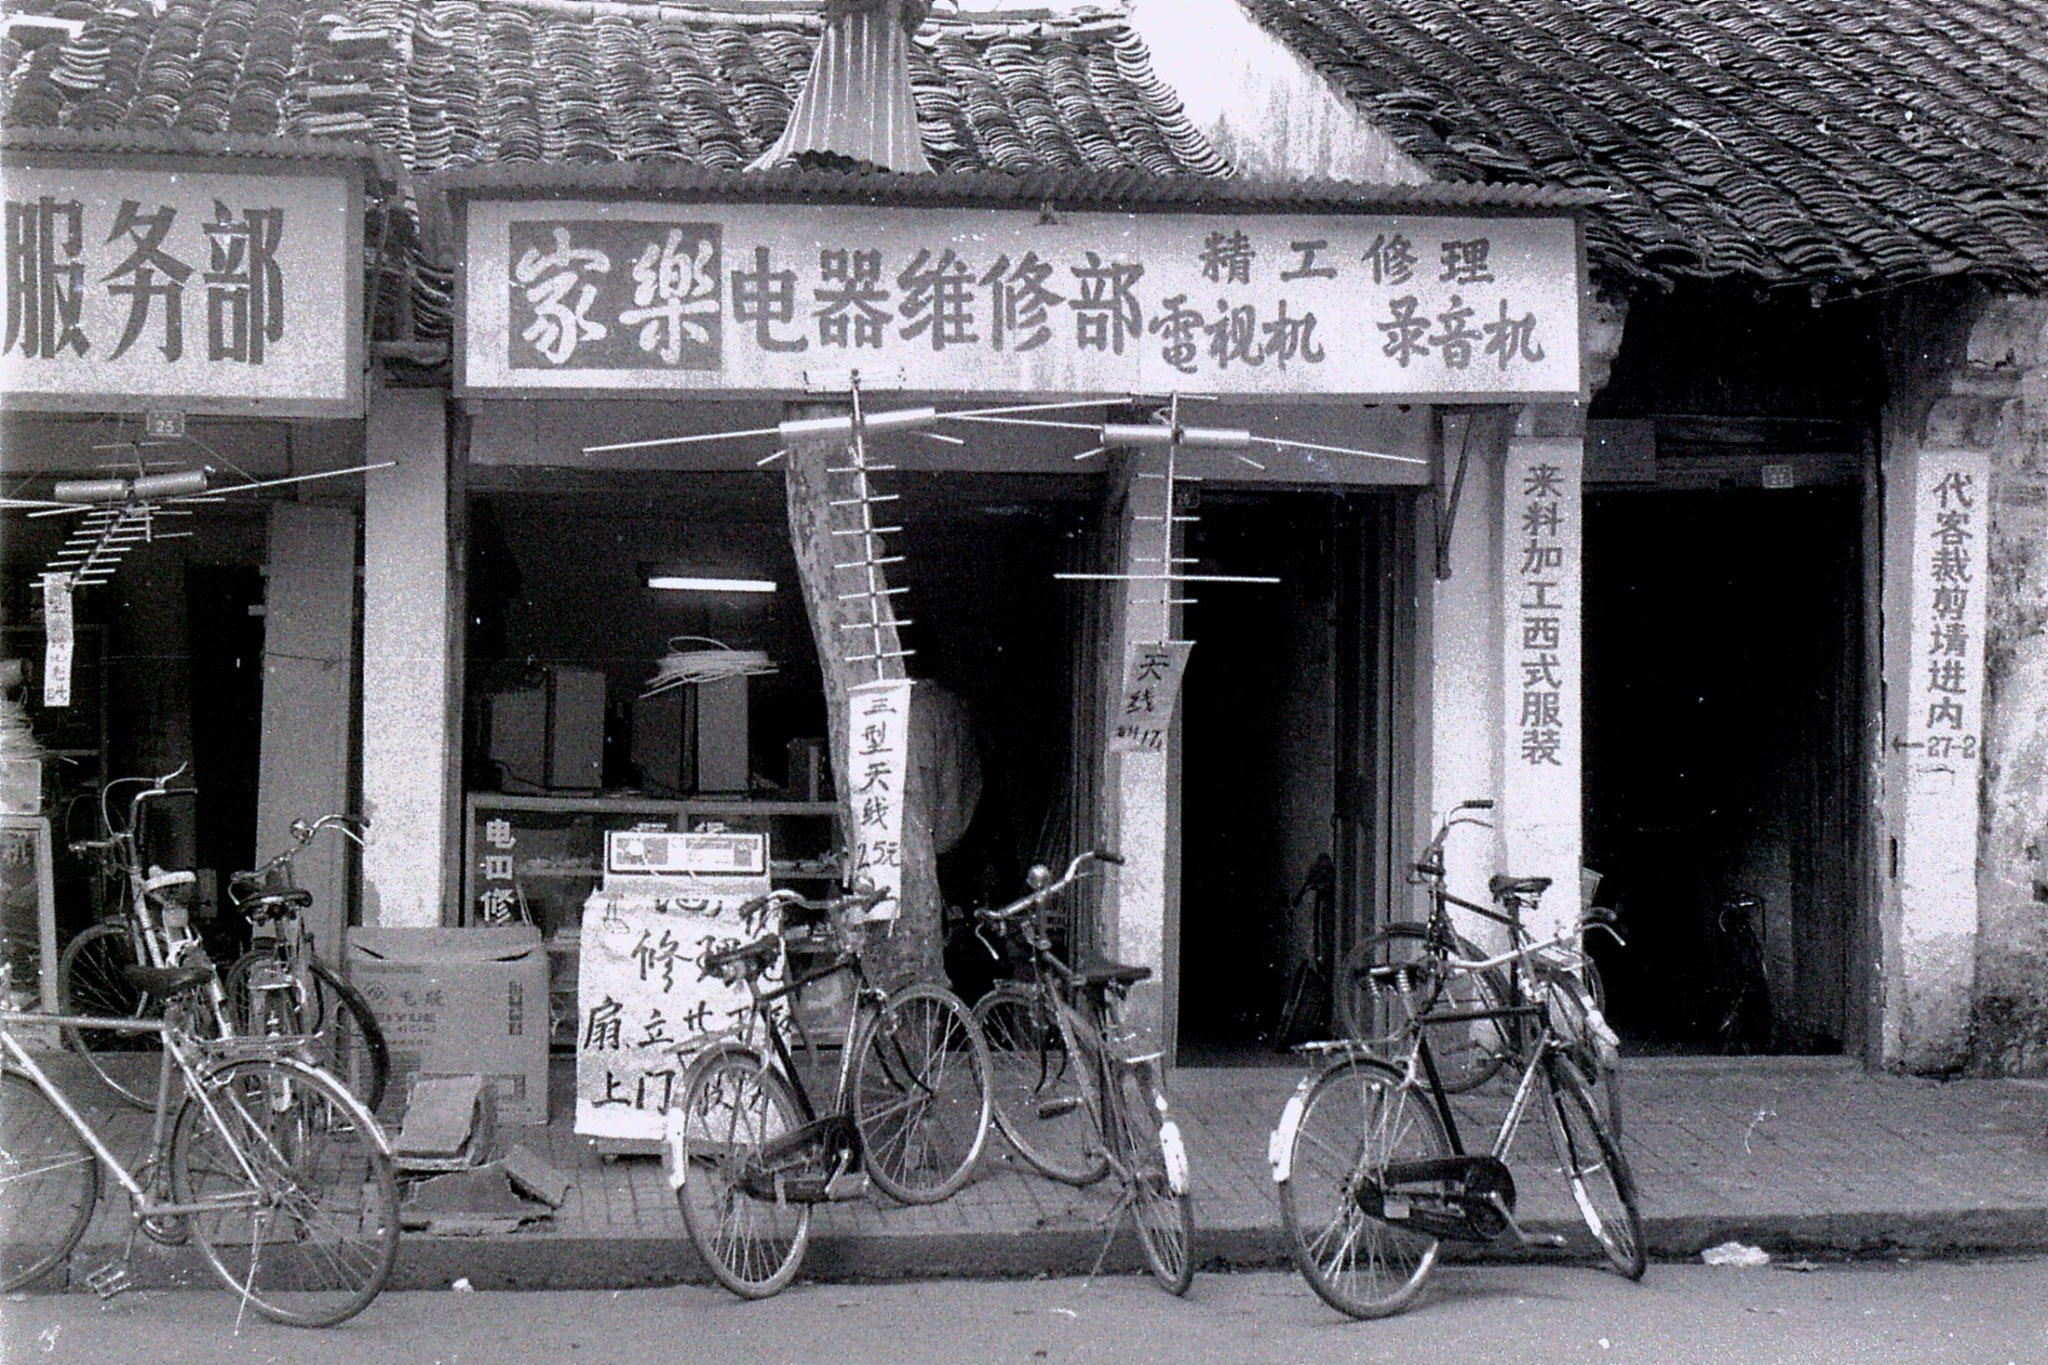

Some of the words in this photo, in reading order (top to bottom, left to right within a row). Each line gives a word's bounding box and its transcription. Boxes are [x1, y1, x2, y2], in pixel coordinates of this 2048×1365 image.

[2, 196, 285, 365] 服务部
[730, 245, 1144, 355] 电器维修部
[1201, 230, 1495, 285] 精工修理
[1377, 295, 1546, 372] 录音机
[1520, 463, 1565, 766] 来料加工西式服装
[859, 698, 898, 831] 三型天线
[1926, 735, 1976, 759] 27-2
